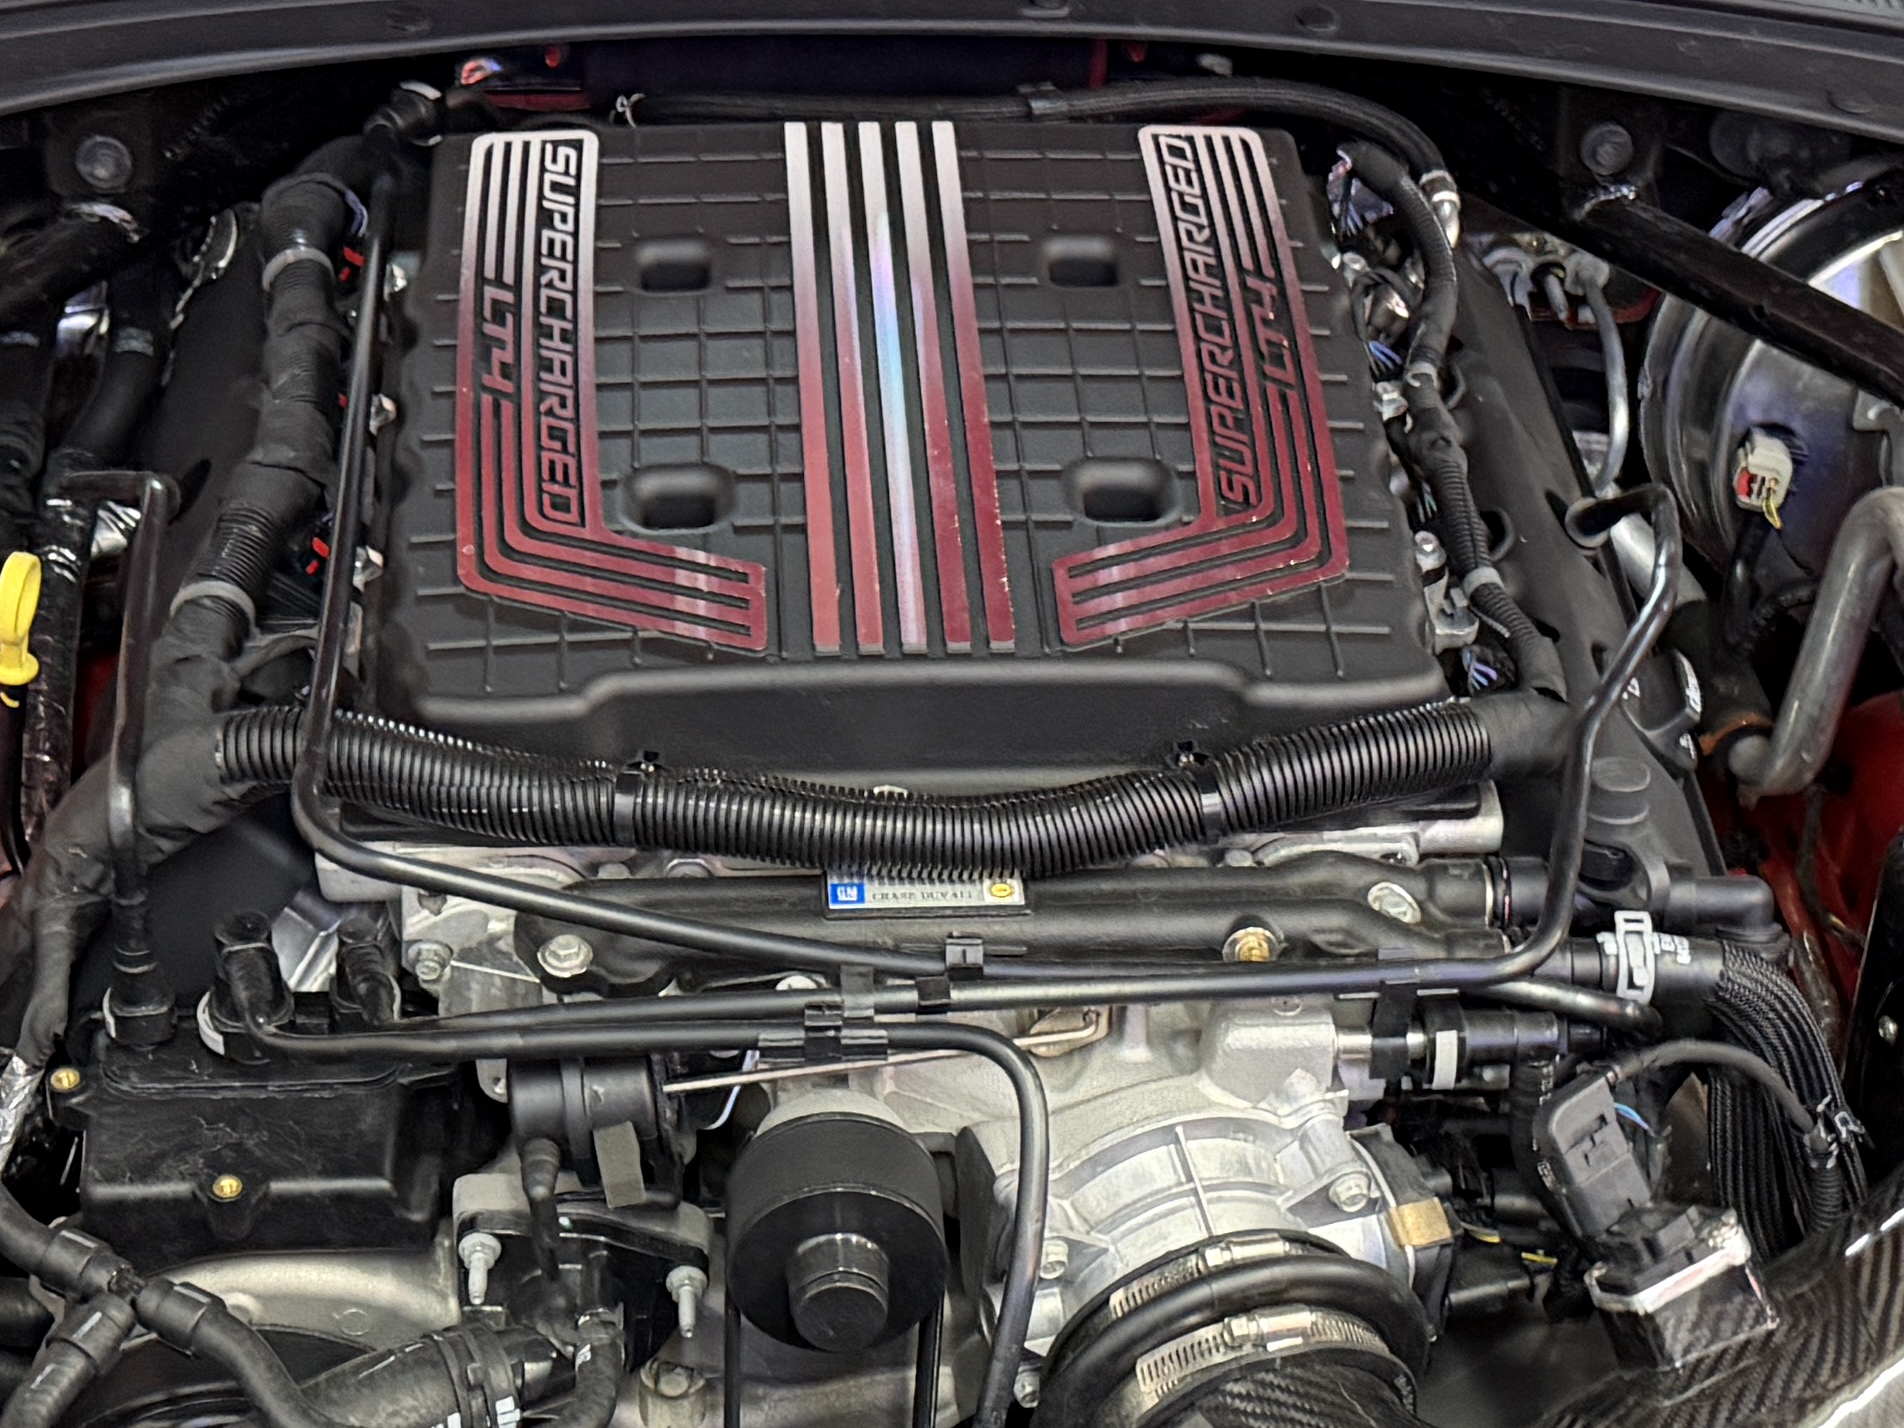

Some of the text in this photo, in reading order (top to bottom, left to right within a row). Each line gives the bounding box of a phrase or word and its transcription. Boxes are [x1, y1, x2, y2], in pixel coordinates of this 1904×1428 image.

[481, 283, 516, 395] LT4
[538, 141, 581, 528] SUPERCHARGED
[1157, 134, 1263, 509] SUPERCHARGED
[1245, 273, 1298, 393] LT4
